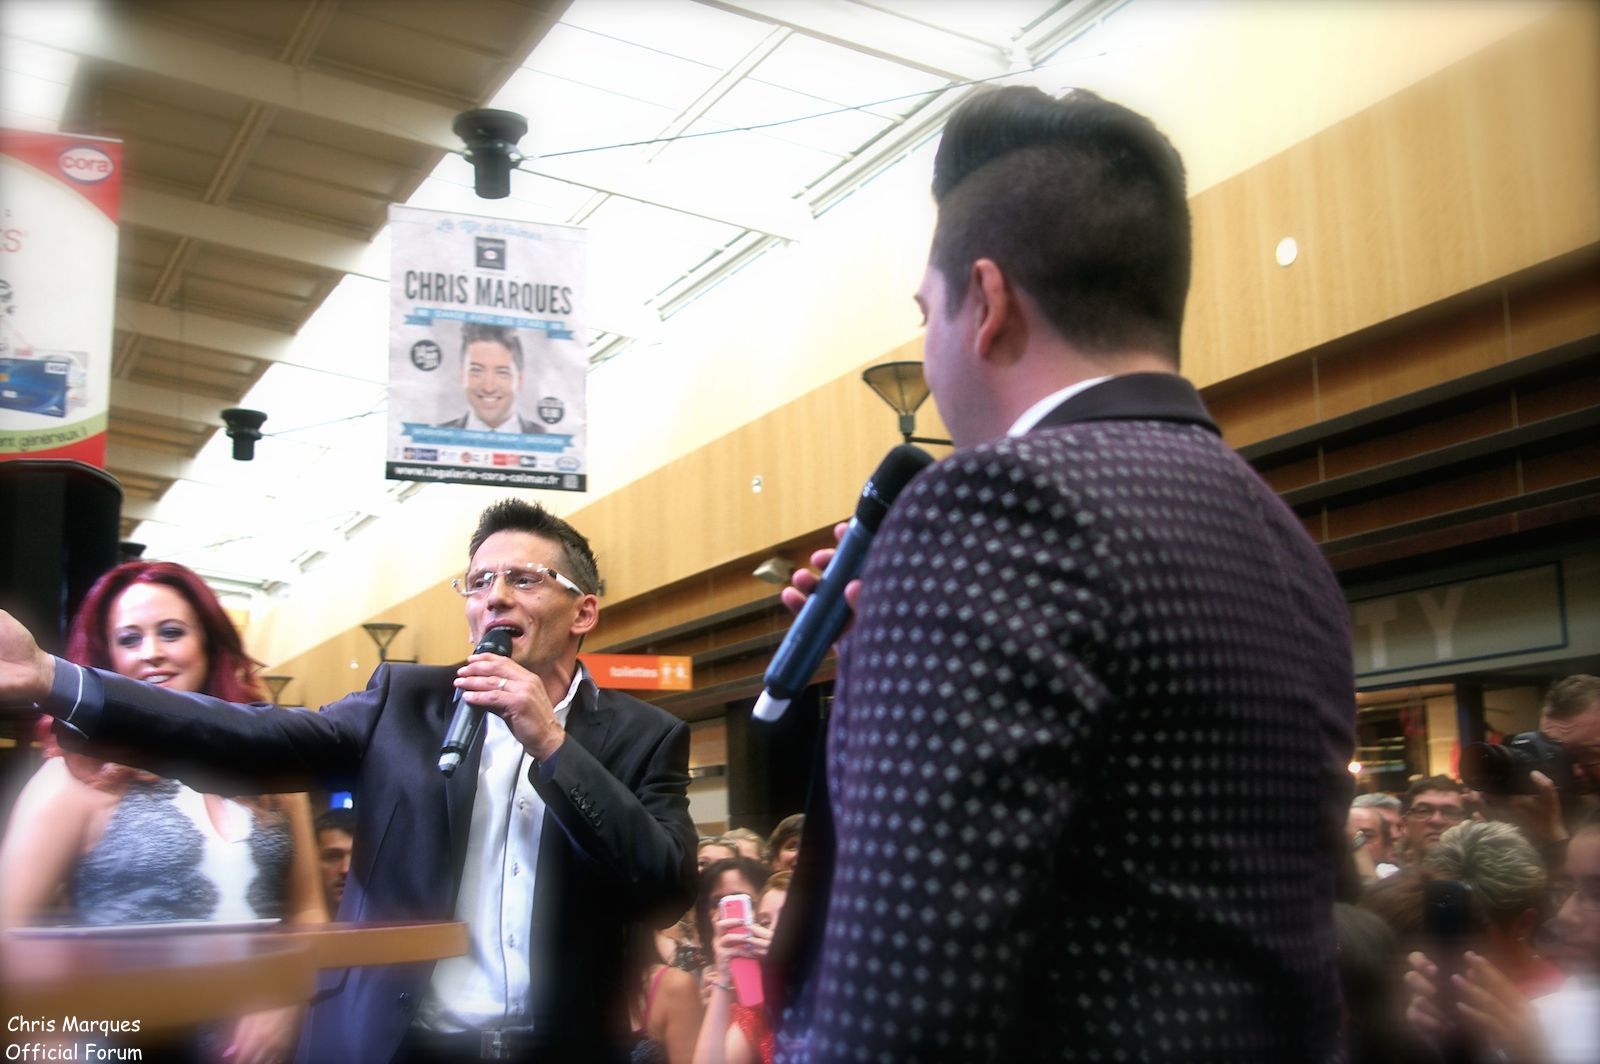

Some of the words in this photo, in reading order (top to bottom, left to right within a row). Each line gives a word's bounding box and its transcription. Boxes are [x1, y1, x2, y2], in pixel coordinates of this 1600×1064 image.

[62, 156, 110, 173] cora
[405, 270, 468, 305] CHRIS
[475, 277, 572, 316] MARQUES
